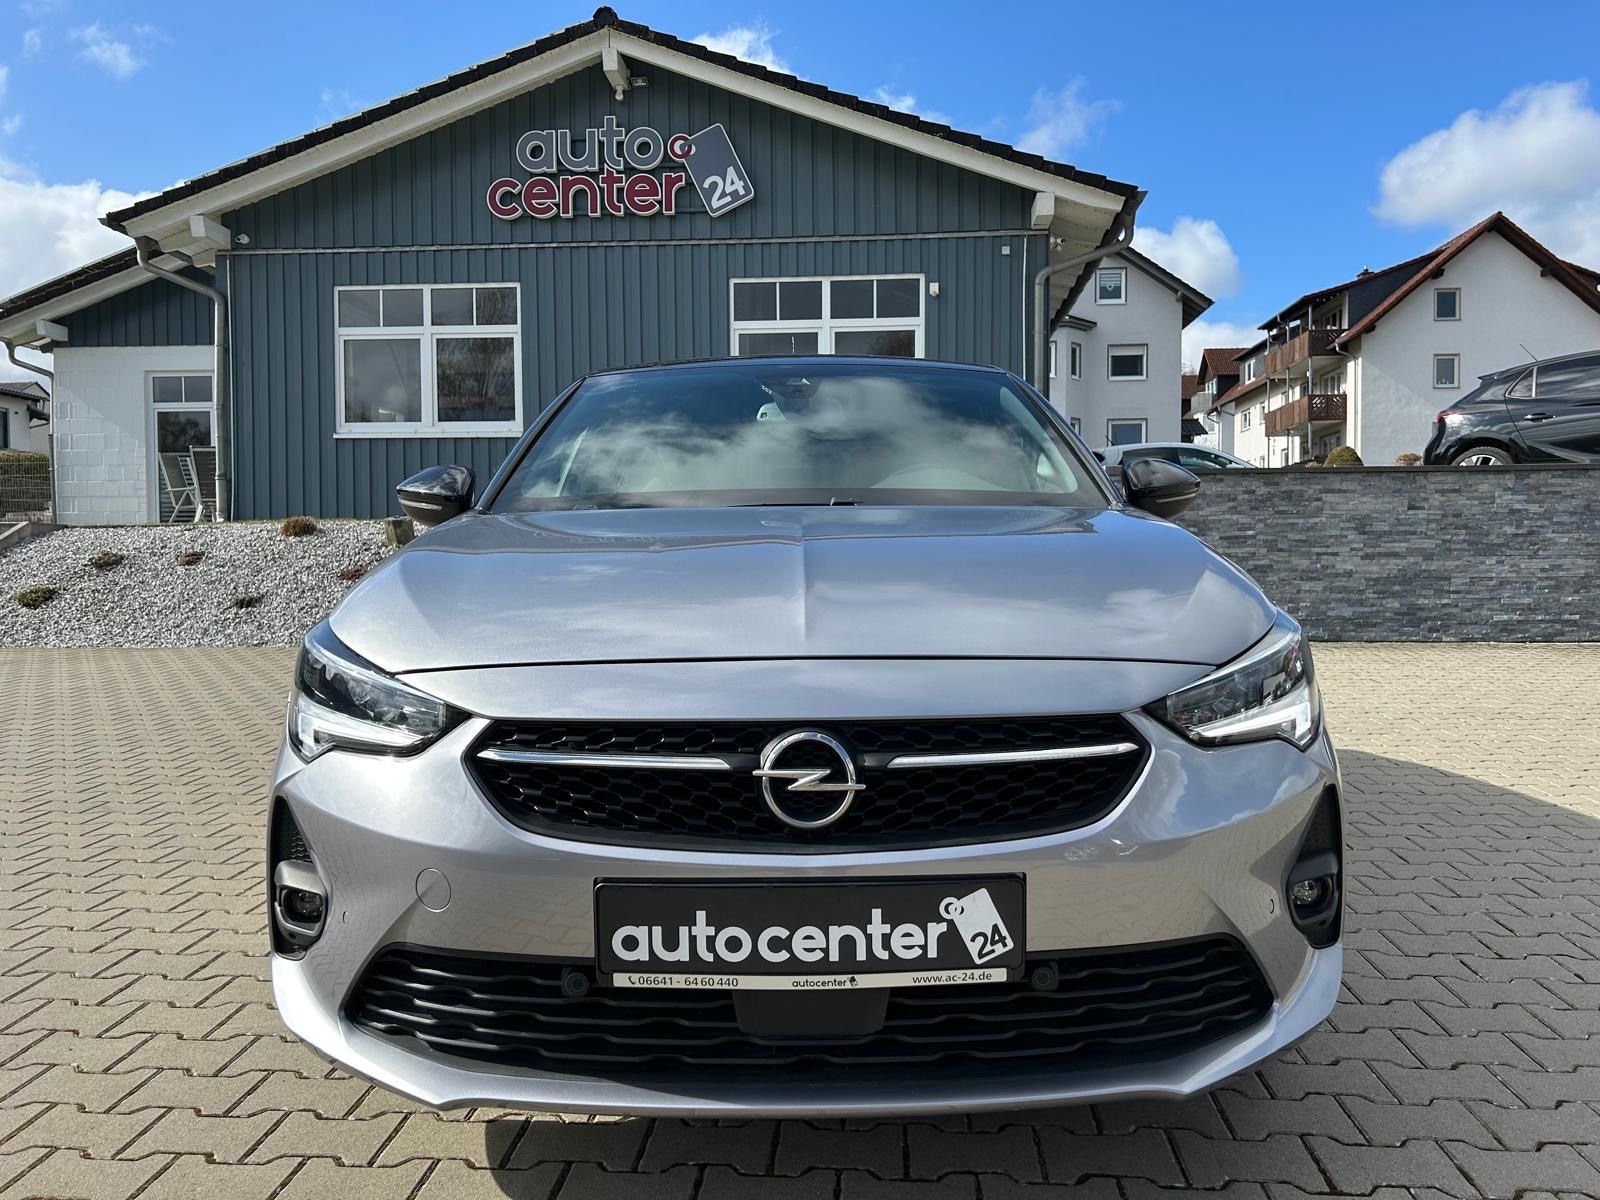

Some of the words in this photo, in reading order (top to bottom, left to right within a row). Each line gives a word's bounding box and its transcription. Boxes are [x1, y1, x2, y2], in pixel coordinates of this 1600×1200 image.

[516, 116, 662, 172] auto
[487, 165, 685, 218] center
[703, 166, 745, 209] 24
[612, 909, 947, 963] autocenter
[970, 924, 1008, 959] 24
[638, 976, 673, 986] 06641
[792, 979, 847, 988] autocenter
[912, 972, 992, 984] www.ac-24.de
